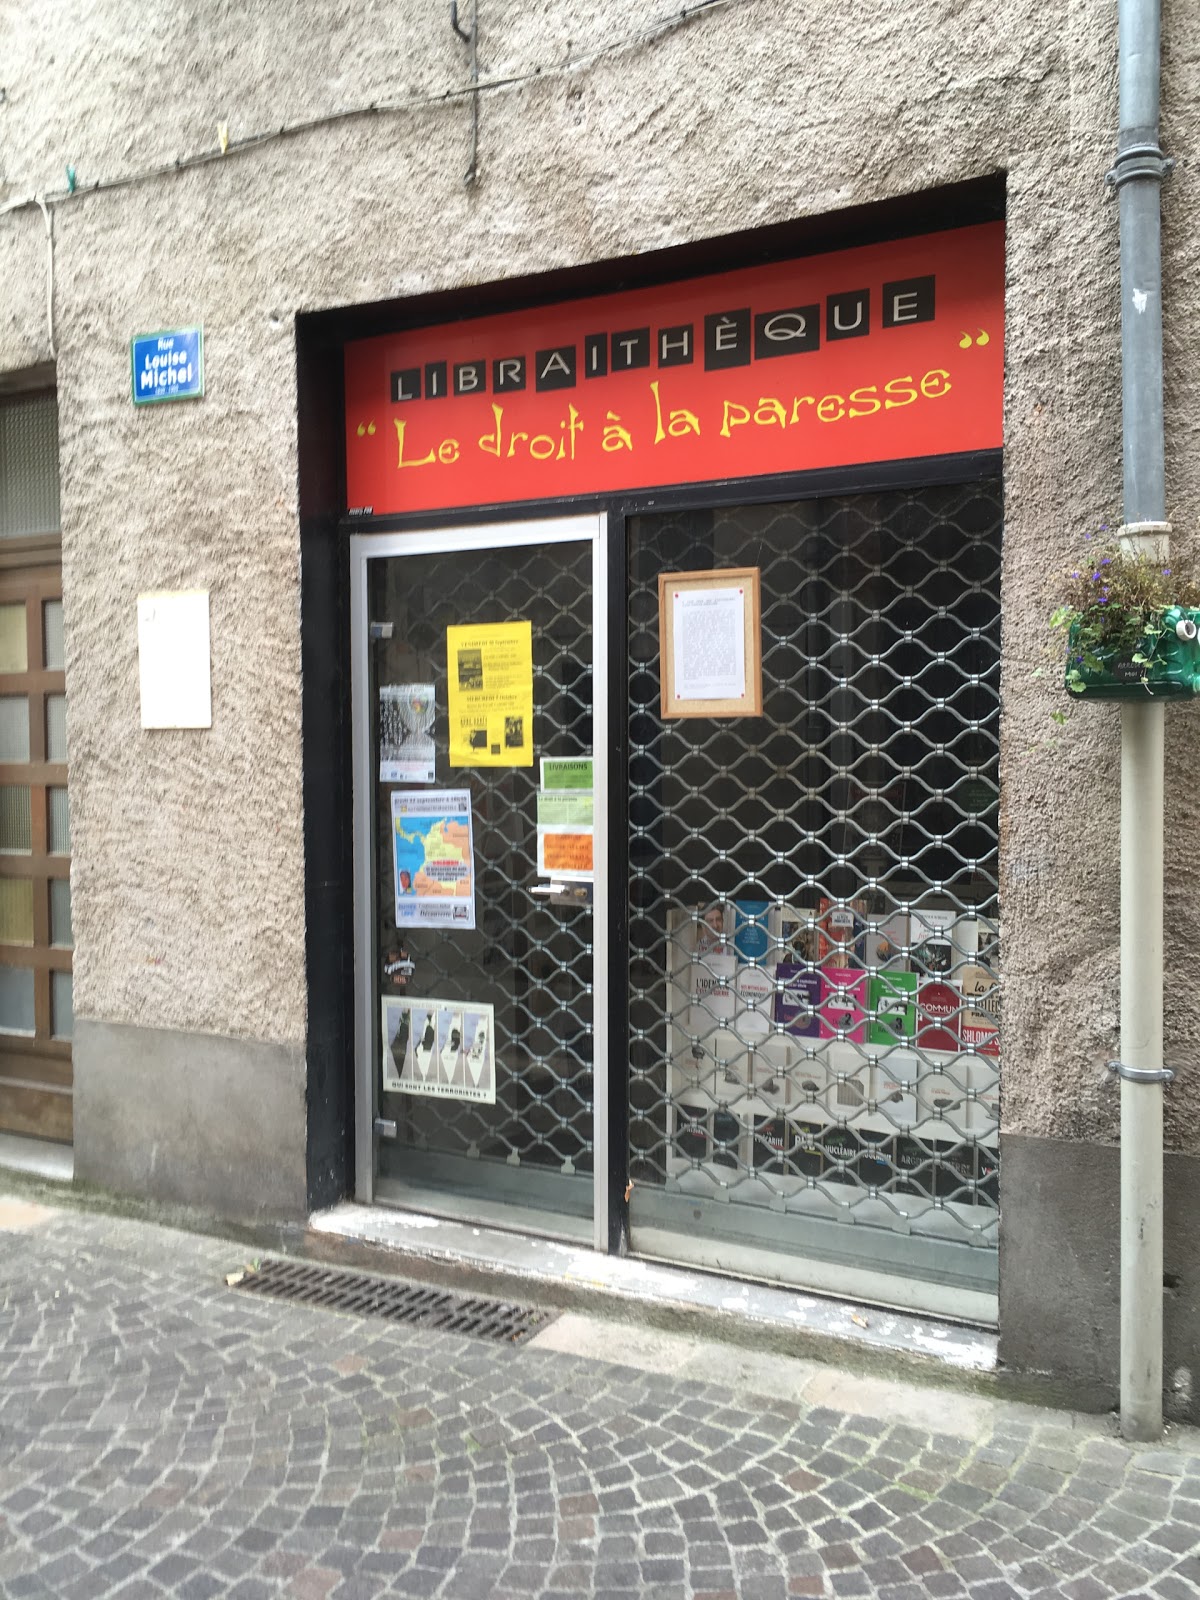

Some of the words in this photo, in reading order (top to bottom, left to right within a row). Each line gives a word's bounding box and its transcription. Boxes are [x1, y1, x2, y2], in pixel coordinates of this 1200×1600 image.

[158, 337, 174, 351] Rue
[397, 291, 918, 401] LIBRAITHÈQUE
[145, 349, 187, 371] Louise
[141, 362, 192, 390] Michel
[393, 417, 460, 469] Le
[478, 402, 584, 461] droit
[602, 410, 633, 453] à
[649, 381, 701, 445] la
[719, 368, 952, 438] paresse
[549, 763, 588, 771] LIVRAISONS
[845, 1013, 853, 1026] 2
